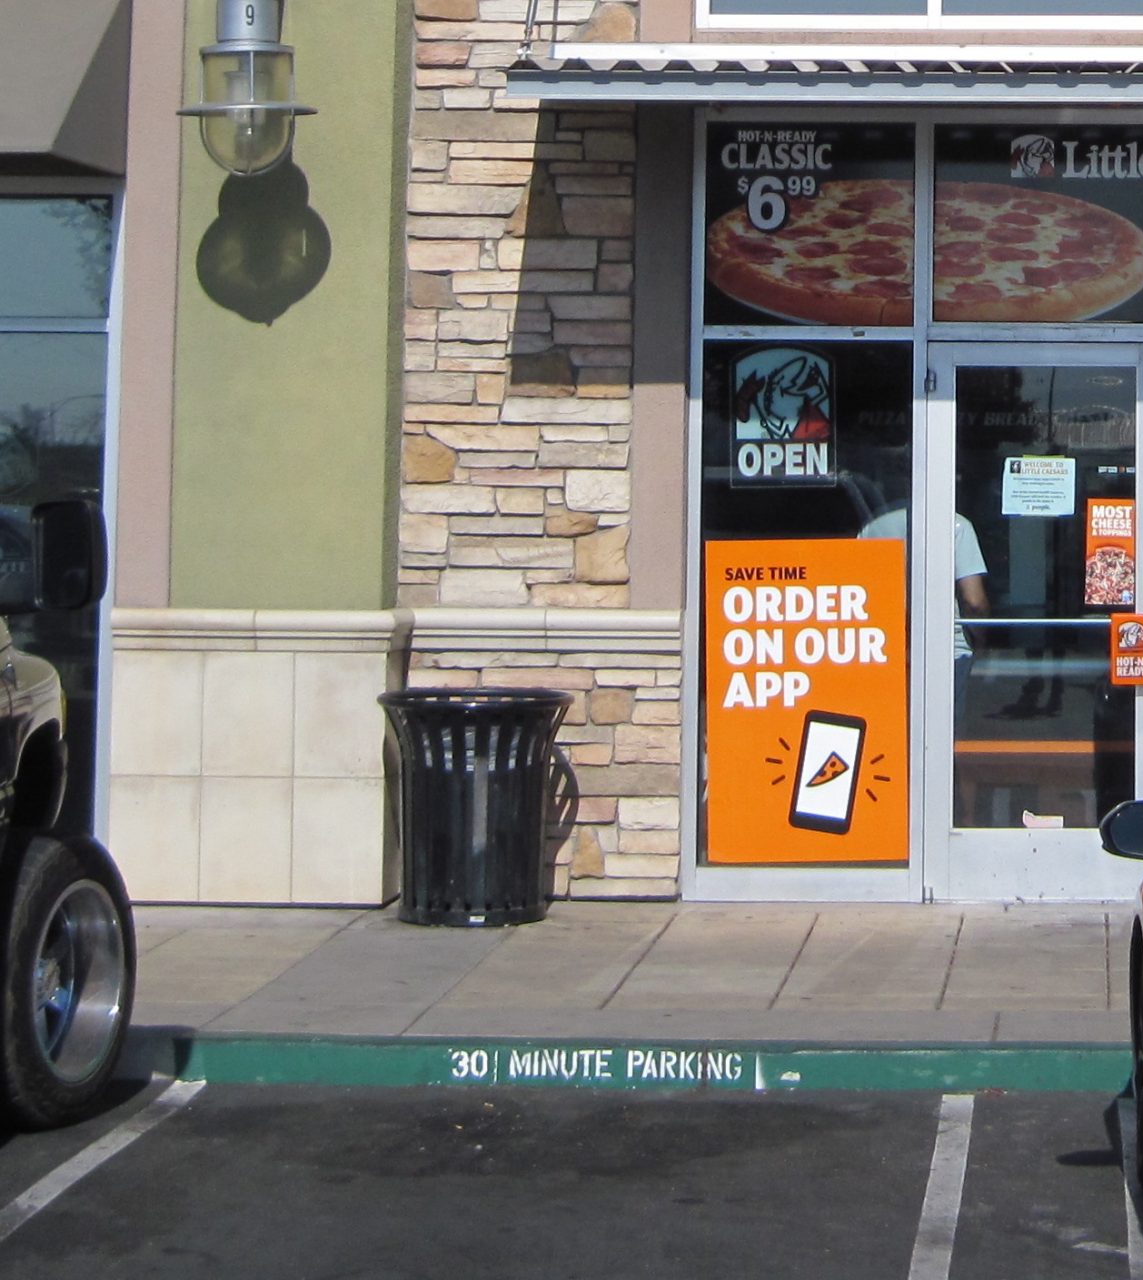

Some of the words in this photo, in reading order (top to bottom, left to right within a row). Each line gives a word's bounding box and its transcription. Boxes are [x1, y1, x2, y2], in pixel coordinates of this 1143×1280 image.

[245, 3, 255, 26] 9
[738, 130, 817, 142] HOT-N-READY
[721, 143, 833, 171] CLASSIC
[737, 442, 829, 476] OPEN
[1091, 505, 1133, 518] MOST
[1091, 519, 1132, 529] CHEESE
[1098, 529, 1132, 537] TOPPINGS
[724, 567, 764, 581] SAVE
[769, 566, 807, 580] TIME
[722, 585, 868, 623] ORDER
[722, 629, 784, 665] ON
[794, 627, 887, 665] OUR
[722, 672, 810, 708] APP
[451, 1050, 488, 1077] 30
[508, 1049, 613, 1078] MINUTE
[627, 1050, 742, 1080] PARKING
